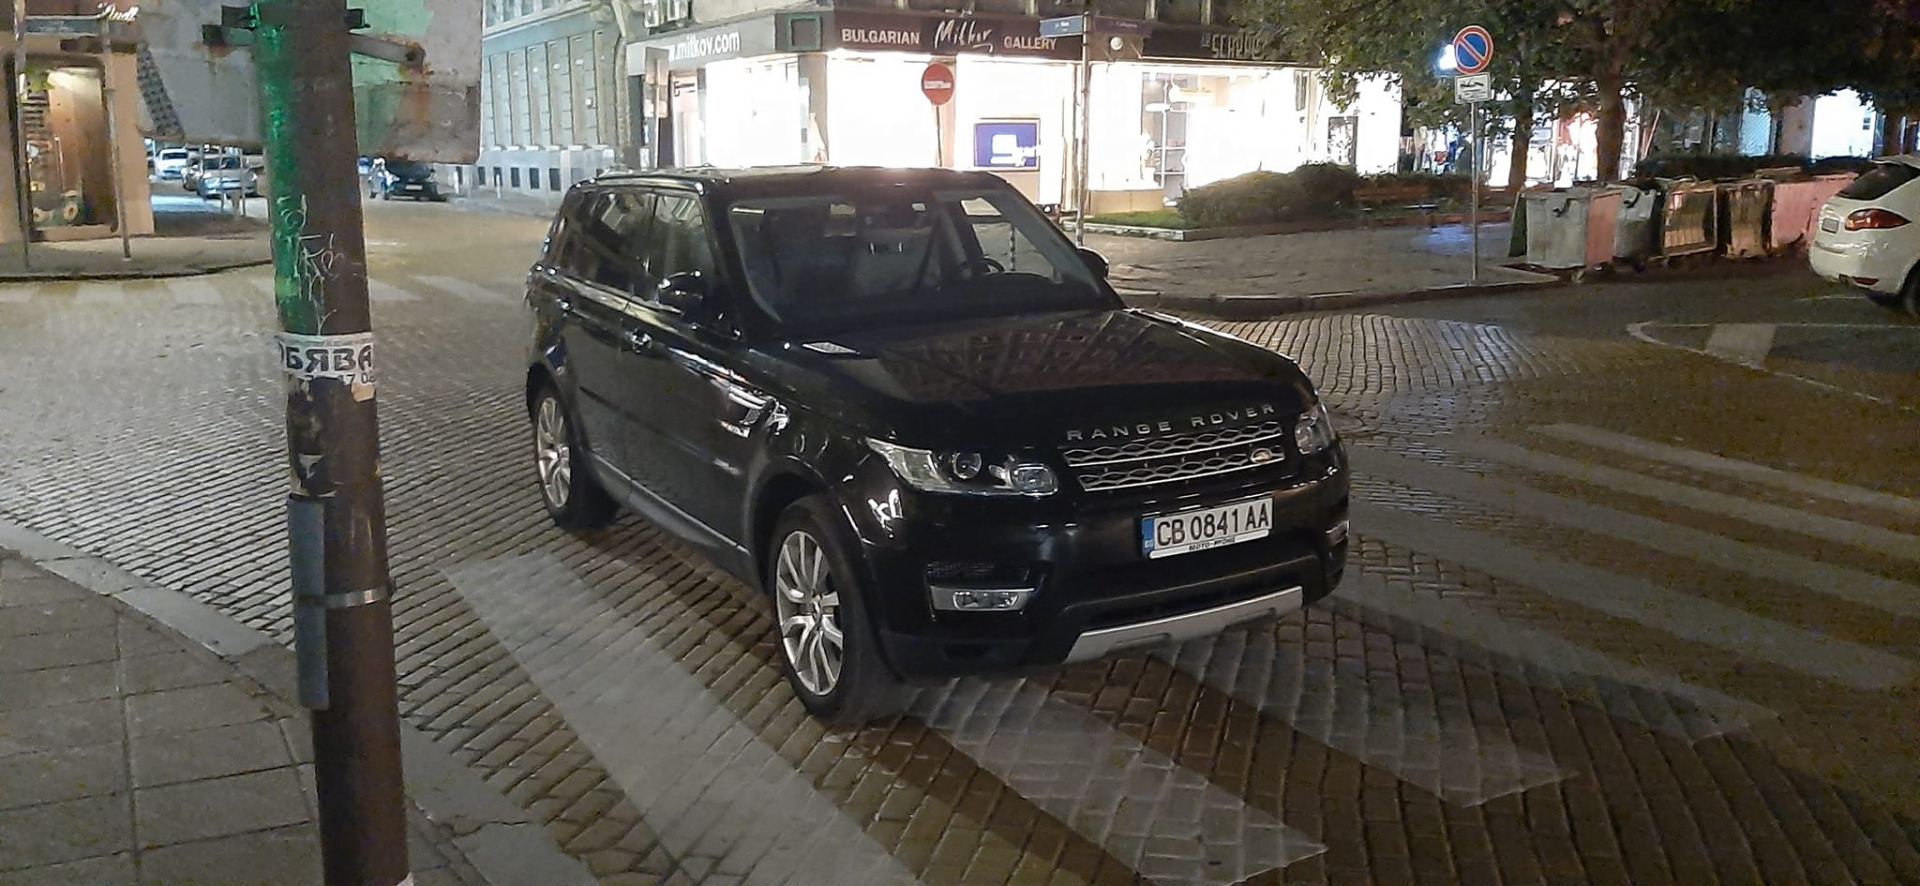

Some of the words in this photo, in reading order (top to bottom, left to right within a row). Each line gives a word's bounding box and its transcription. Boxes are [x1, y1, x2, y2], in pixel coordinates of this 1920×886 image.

[841, 28, 920, 45] BULGARIAN
[1003, 35, 1058, 50] GALLERY
[1066, 421, 1171, 441] RANGE
[1190, 404, 1275, 428] ROVER
[1157, 519, 1185, 546] CB
[1190, 508, 1239, 541] 0841
[1245, 503, 1269, 530] AA
